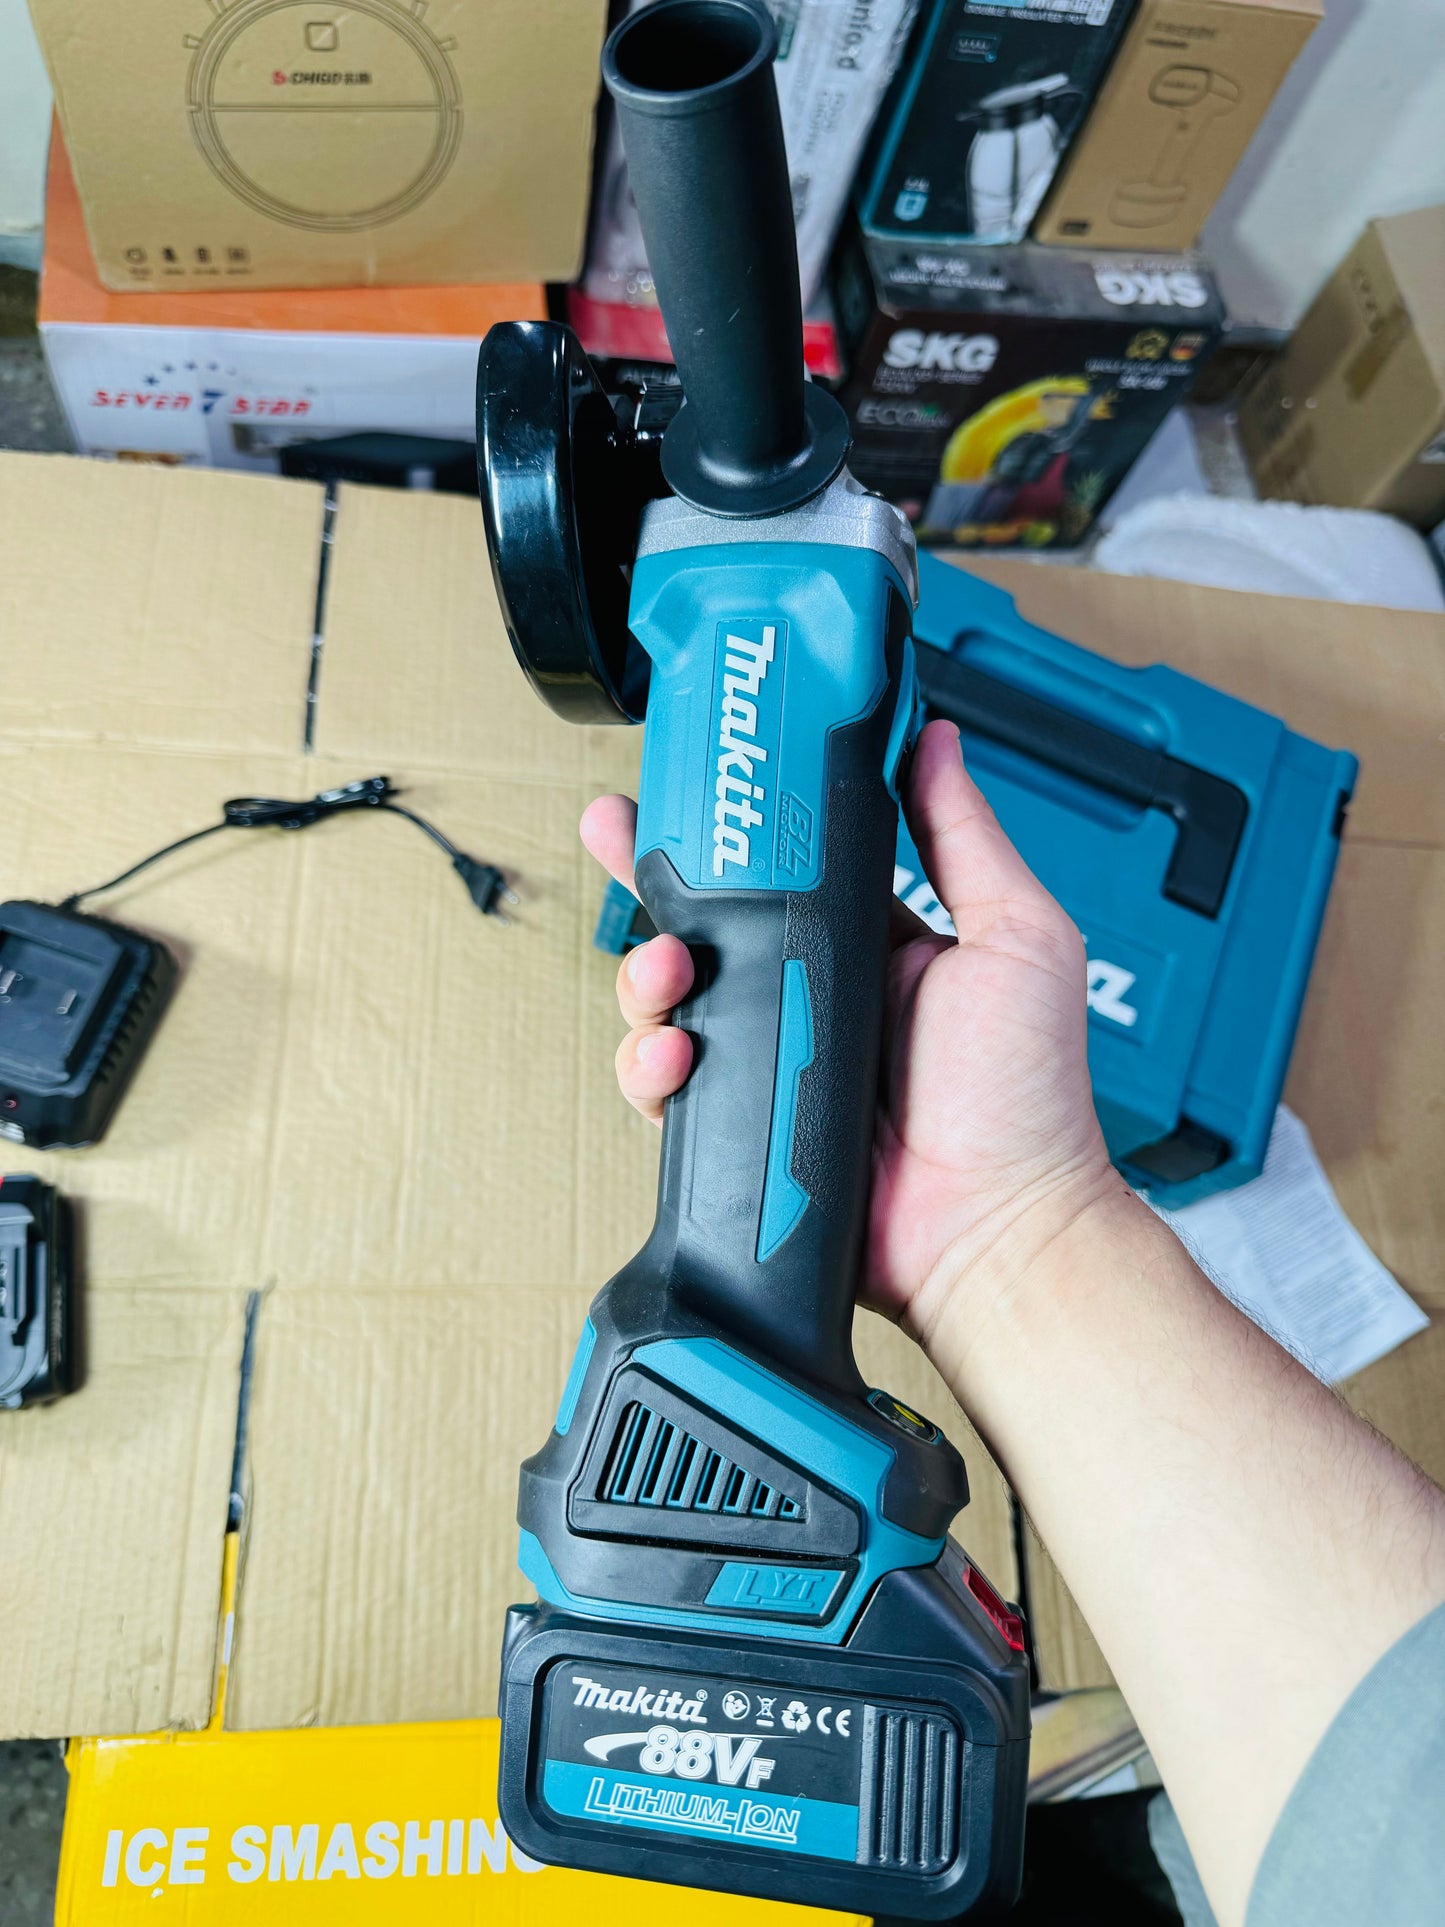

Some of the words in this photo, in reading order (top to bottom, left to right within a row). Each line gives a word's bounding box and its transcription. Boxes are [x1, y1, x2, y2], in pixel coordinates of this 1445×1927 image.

[1094, 272, 1207, 308] SKG
[883, 328, 998, 373] SKG
[734, 1568, 825, 1608] LYT
[101, 1828, 209, 1887] ICE
